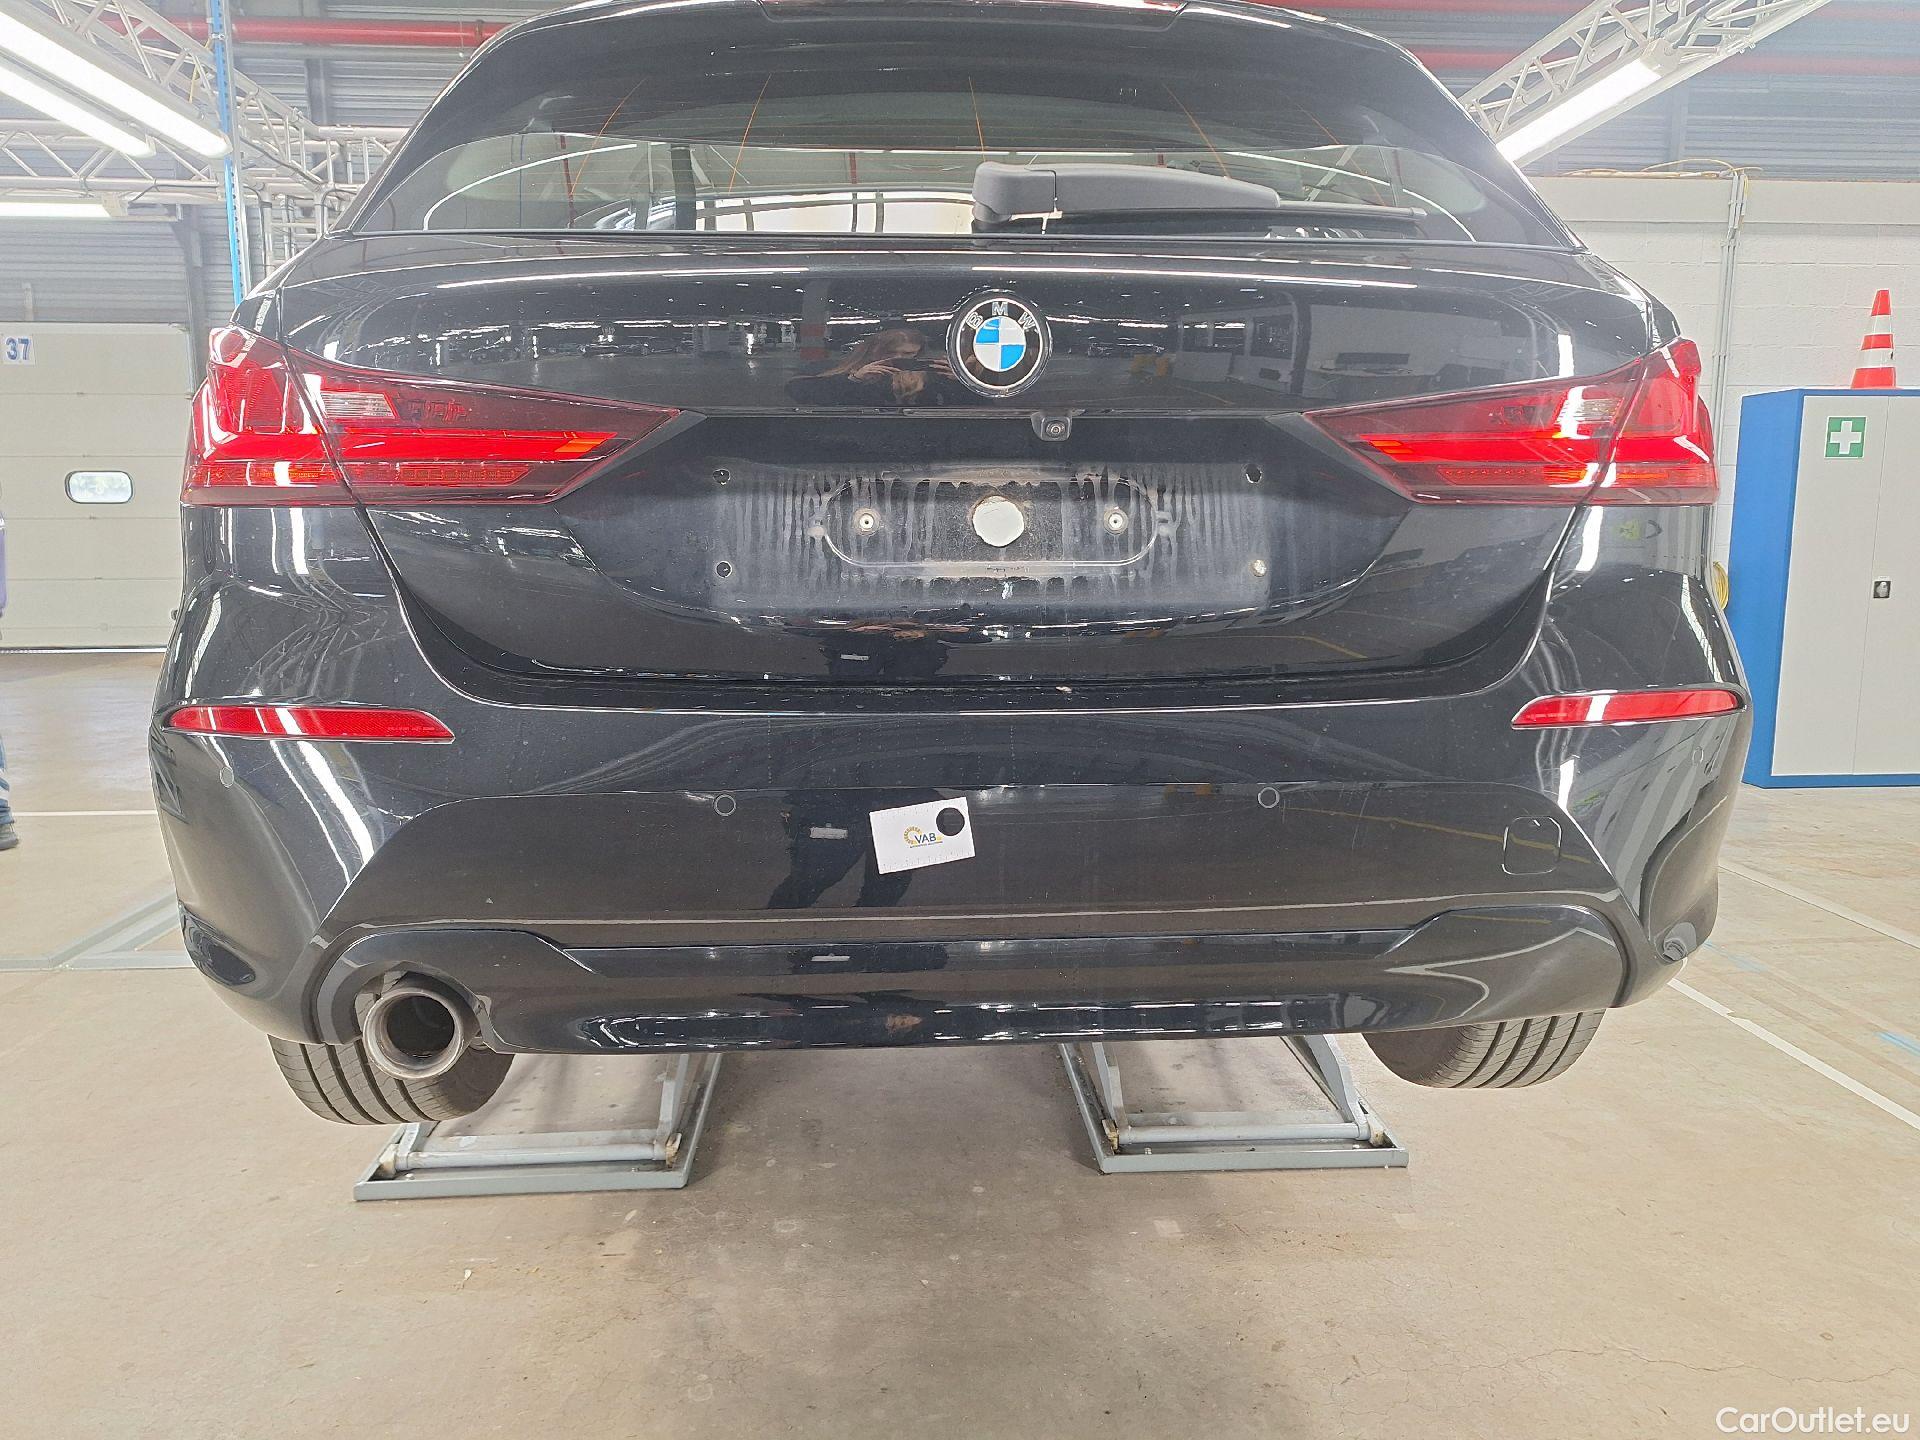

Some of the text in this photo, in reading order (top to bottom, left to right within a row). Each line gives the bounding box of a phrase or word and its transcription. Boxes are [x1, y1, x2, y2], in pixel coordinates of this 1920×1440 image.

[965, 301, 1036, 330] BMW
[6, 337, 29, 360] 37
[914, 832, 937, 844] VAB
